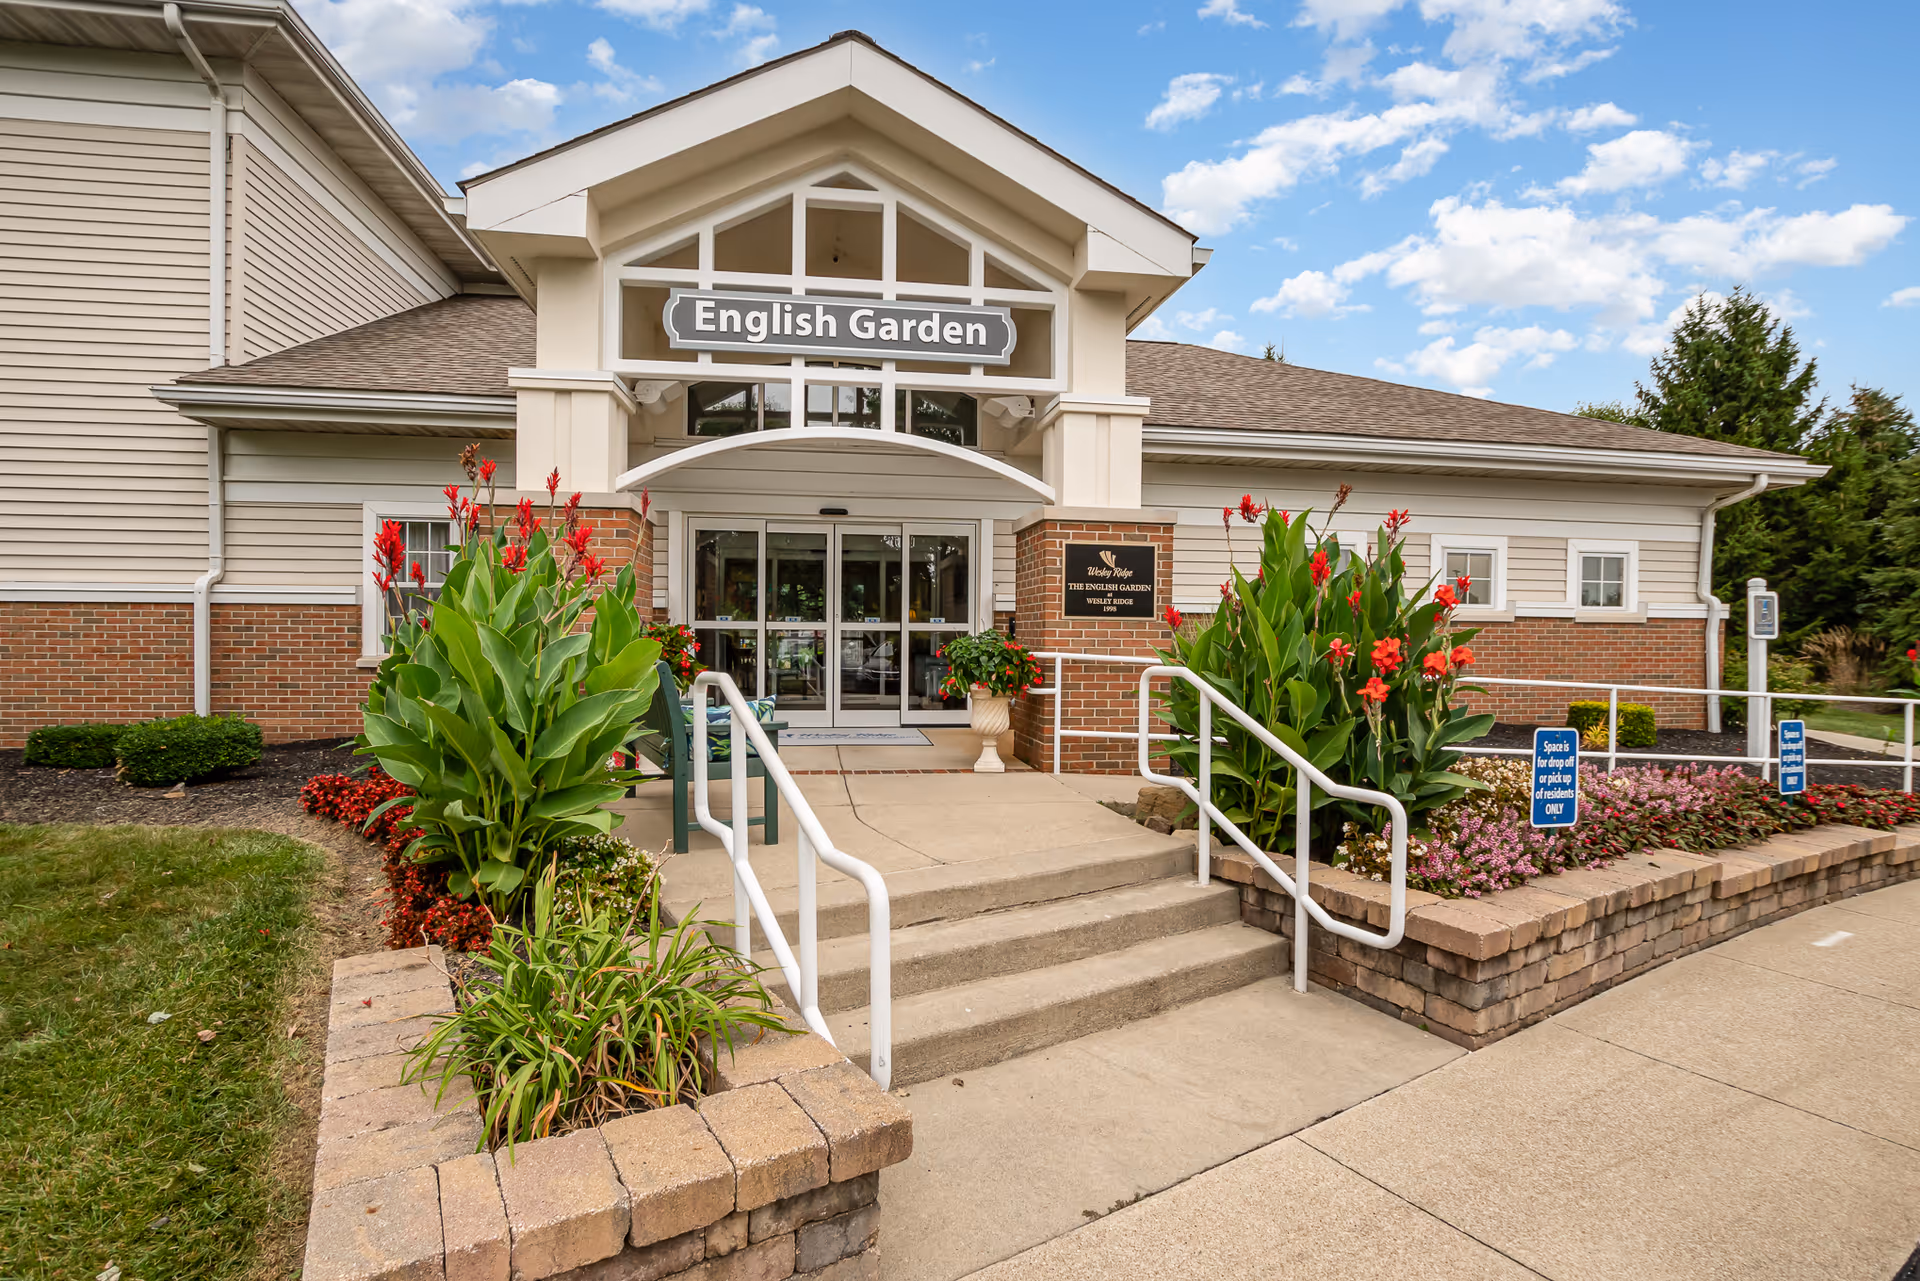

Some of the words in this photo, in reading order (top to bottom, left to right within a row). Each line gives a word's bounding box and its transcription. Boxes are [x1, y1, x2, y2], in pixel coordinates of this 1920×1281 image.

[694, 299, 838, 343] English
[849, 309, 988, 346] Garden
[1087, 567, 1112, 579] Wesley
[1113, 567, 1133, 579] Ridge
[1068, 583, 1084, 591] THE
[1085, 583, 1118, 591] ENGLISH
[1544, 741, 1563, 755] Space
[1564, 740, 1569, 752] is
[1537, 756, 1547, 768] for
[1548, 756, 1564, 770] drop
[1564, 755, 1575, 768] off
[1539, 774, 1547, 784] or
[1548, 772, 1562, 786] pick
[1563, 774, 1572, 786] up
[1535, 787, 1544, 800] of
[1544, 787, 1574, 800] residents
[1545, 803, 1564, 815] ONLY
